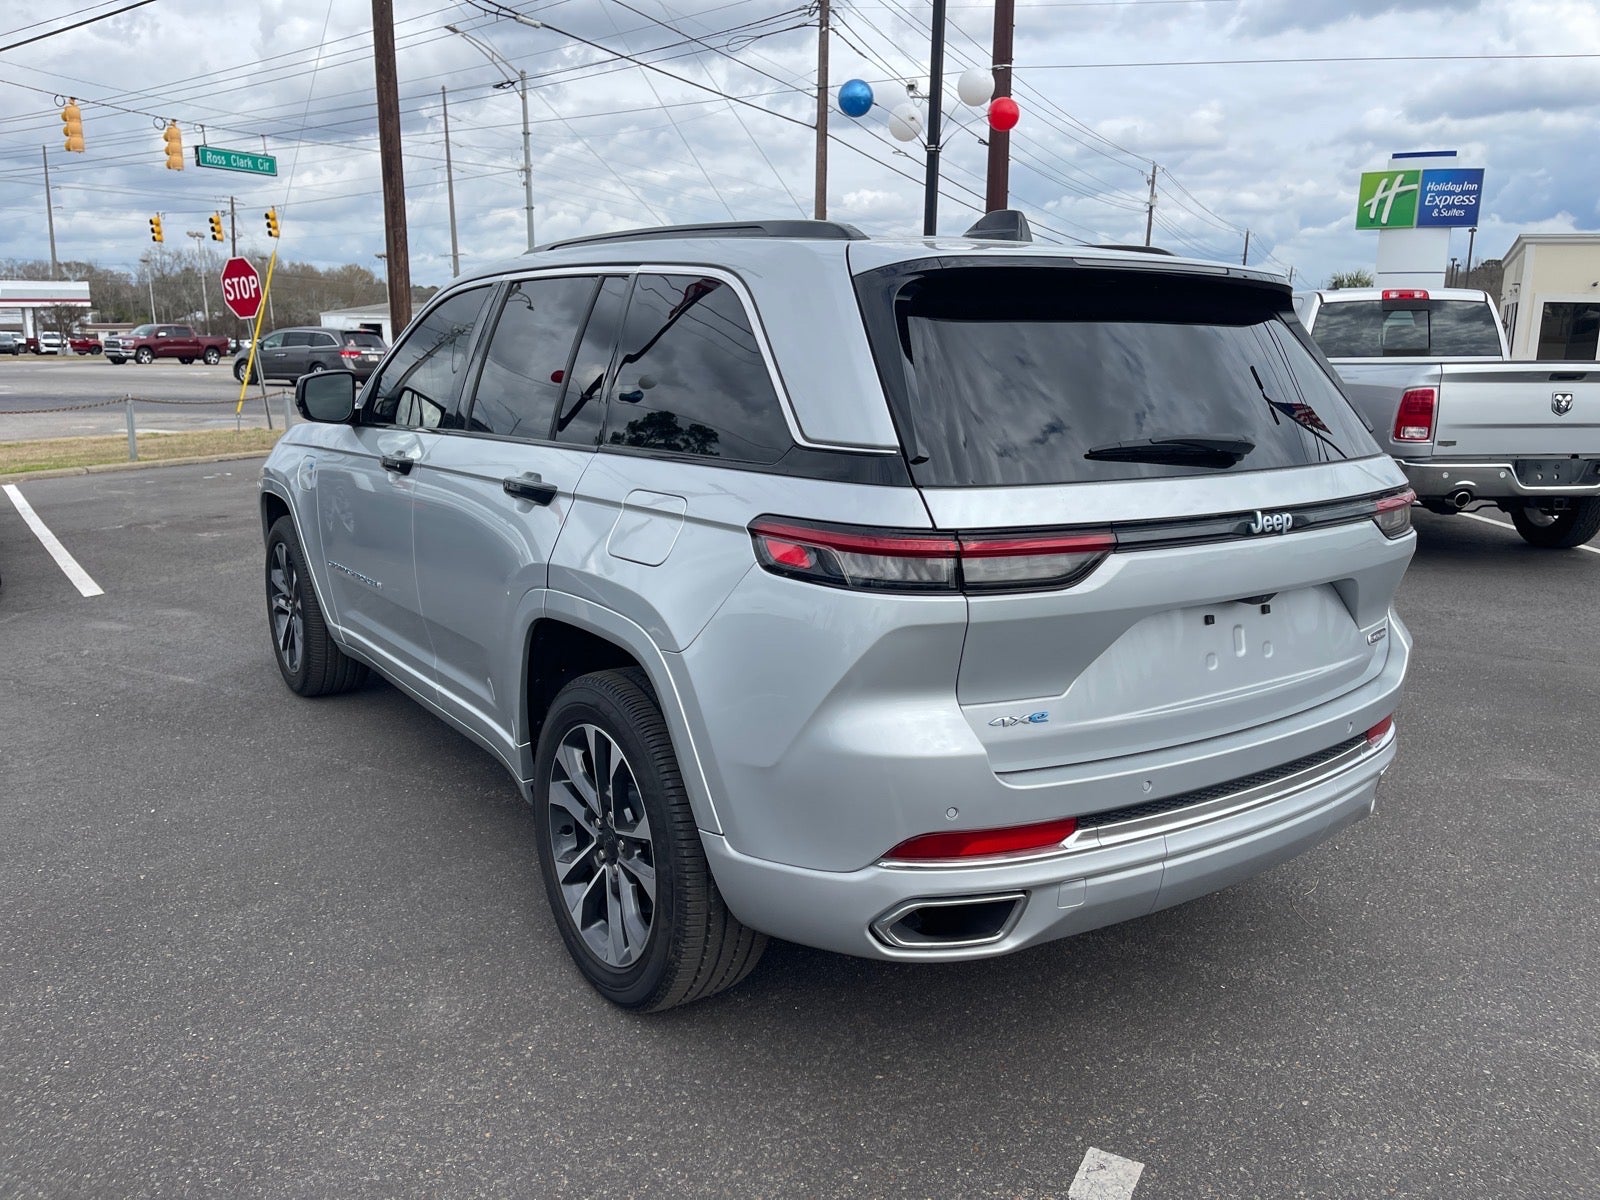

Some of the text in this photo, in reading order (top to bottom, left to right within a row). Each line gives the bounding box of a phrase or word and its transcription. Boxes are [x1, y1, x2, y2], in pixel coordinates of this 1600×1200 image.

[206, 151, 270, 171] Ross Clark Cir
[1426, 181, 1478, 193] Holiday Inn
[1425, 193, 1476, 208] Express
[1432, 208, 1465, 217] & Suites
[224, 275, 258, 301] STOP
[1250, 510, 1293, 534] Jeep
